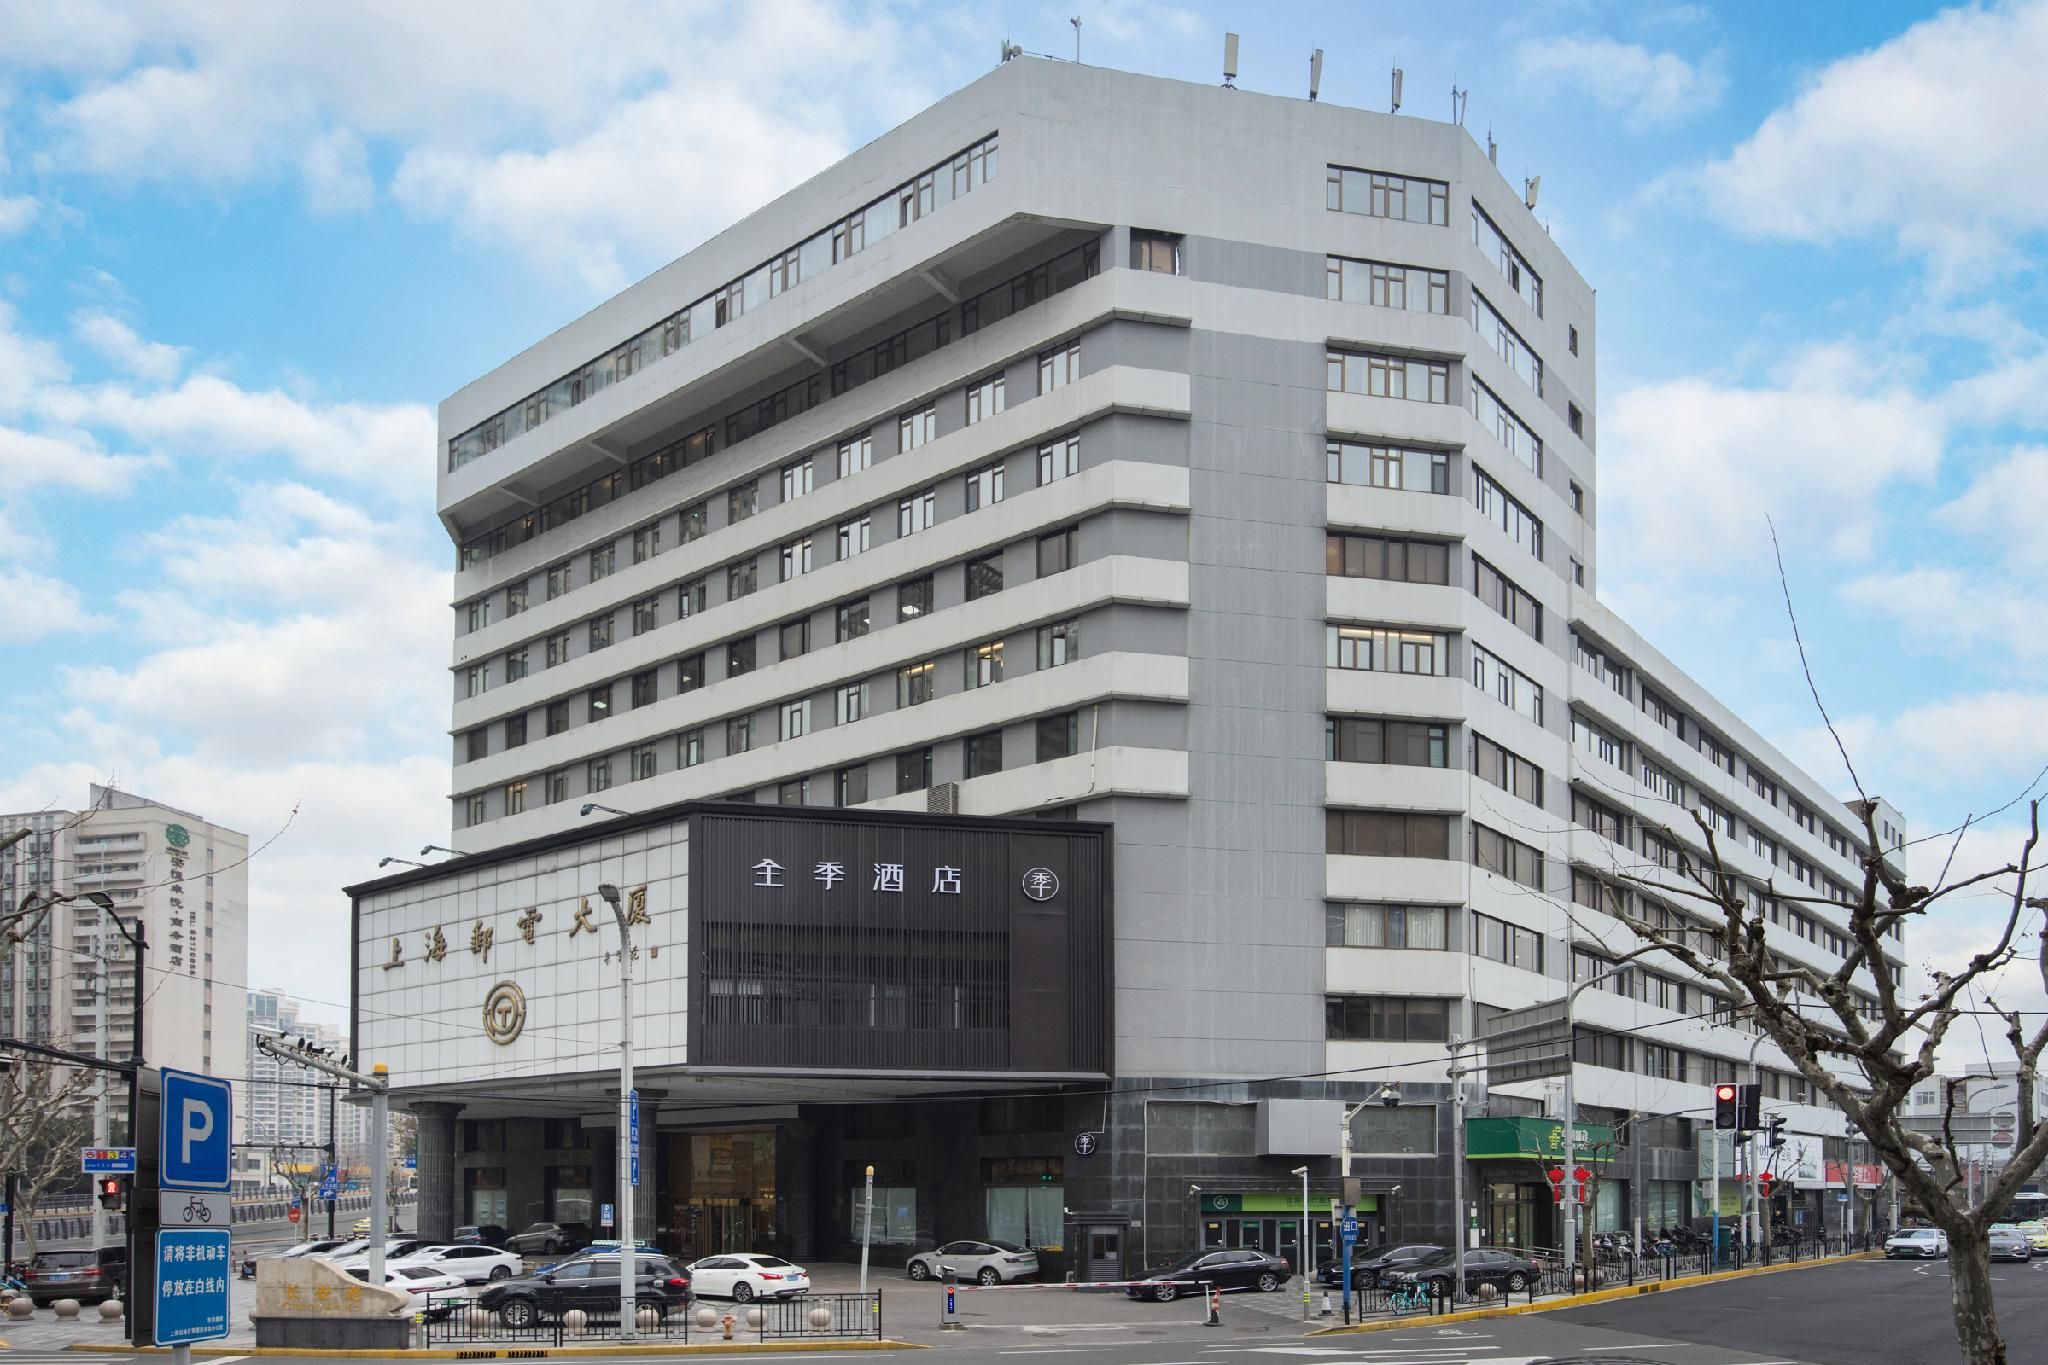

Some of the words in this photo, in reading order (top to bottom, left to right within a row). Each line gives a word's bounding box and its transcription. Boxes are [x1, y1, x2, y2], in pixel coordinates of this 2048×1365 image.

[752, 859, 961, 894] 全季酒店
[182, 1098, 213, 1164] P
[163, 1245, 226, 1263] 请将非机动车
[162, 1276, 225, 1298] 停放在白线内
